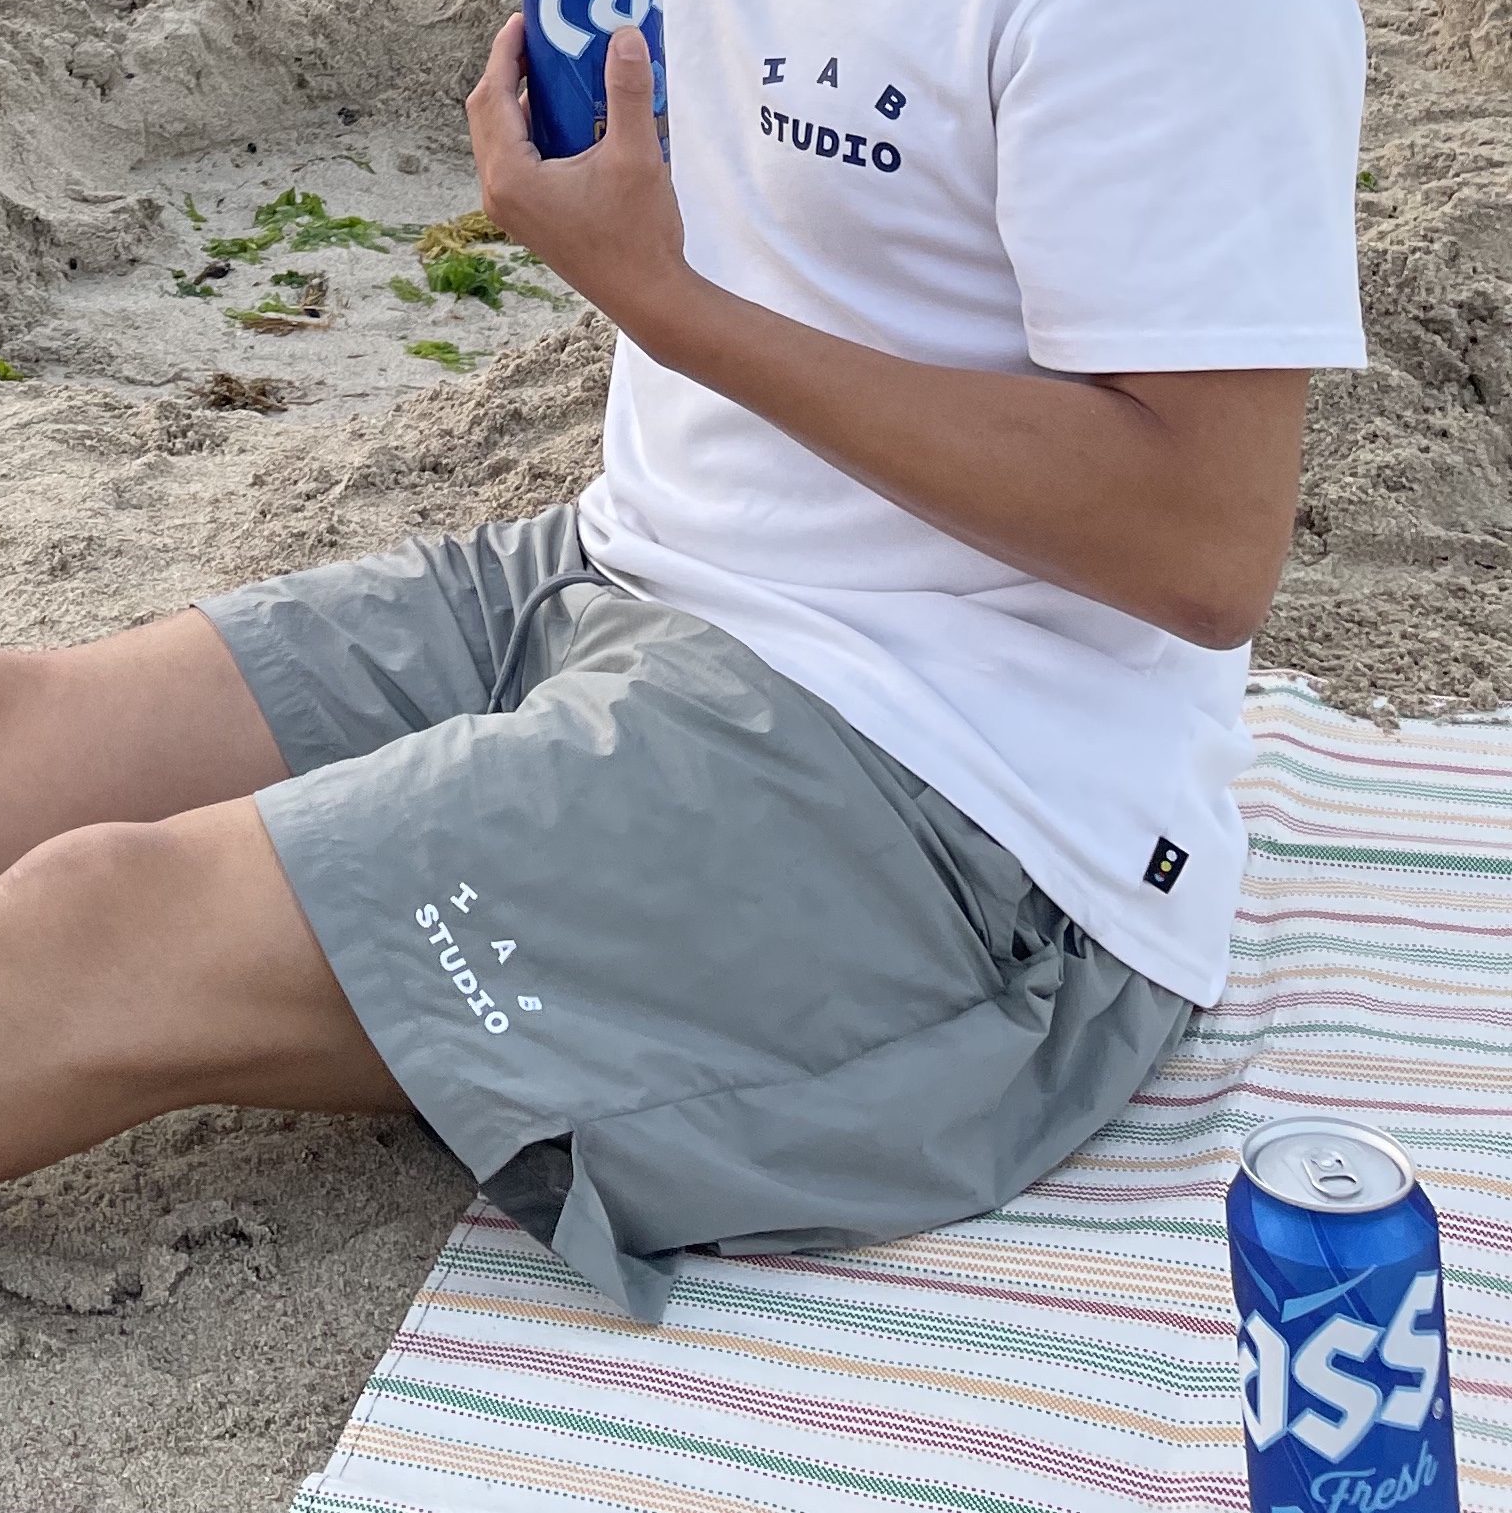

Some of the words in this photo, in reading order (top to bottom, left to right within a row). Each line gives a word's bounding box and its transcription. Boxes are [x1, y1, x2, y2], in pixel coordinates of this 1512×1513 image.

[760, 105, 901, 173] STUDIO
[415, 903, 509, 1034] STUDIO
[1310, 1440, 1438, 1513] Fresh
